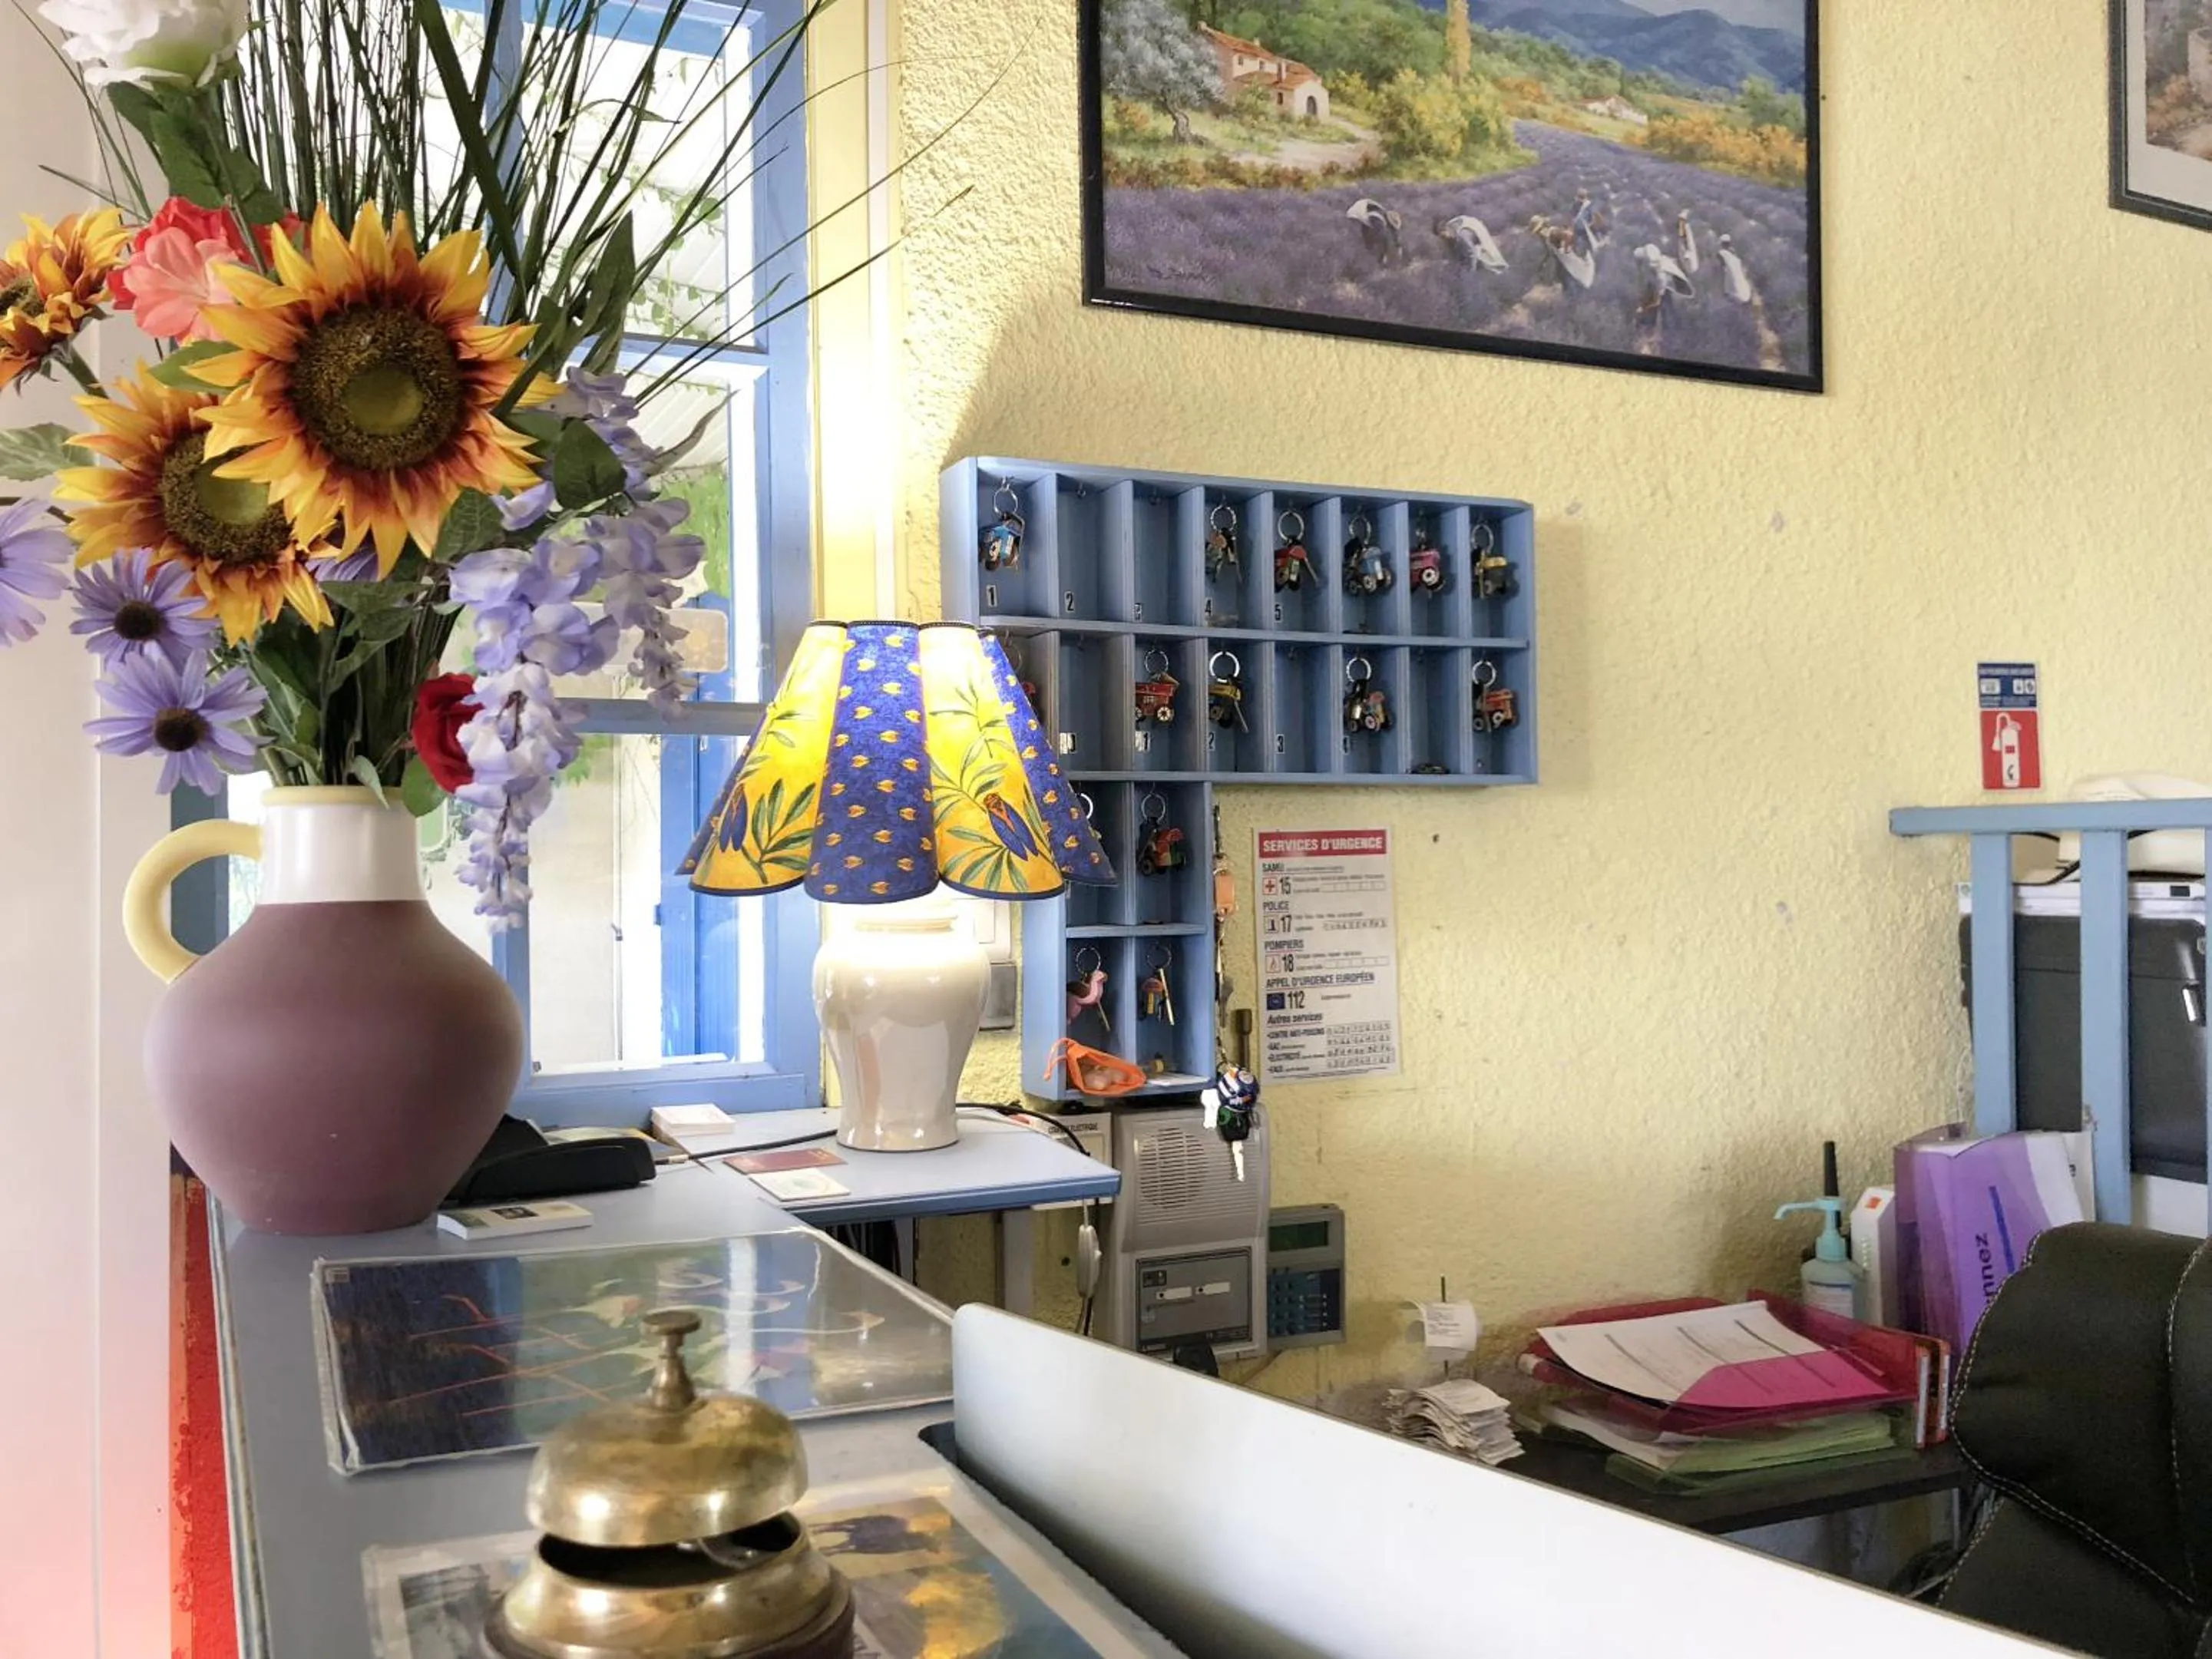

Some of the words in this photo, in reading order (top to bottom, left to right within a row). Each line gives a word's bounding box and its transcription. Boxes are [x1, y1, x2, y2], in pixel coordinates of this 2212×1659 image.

[987, 587, 995, 606] 1
[1066, 592, 1074, 612] 2
[1205, 599, 1212, 616] 4
[1275, 603, 1281, 621] 5
[1263, 838, 1318, 851] SERVICES
[1321, 836, 1383, 851] D'URGENCE
[1262, 862, 1285, 872] SAMU
[1279, 876, 1291, 894] 15
[1262, 901, 1290, 910] POLICE
[1280, 914, 1292, 932] 17
[1264, 939, 1304, 950] POMPIERS
[1281, 953, 1294, 972] 18
[1266, 977, 1290, 988] APPEL
[1291, 974, 1334, 986] D'URGENCE
[1288, 990, 1305, 1009] 112
[1268, 1014, 1291, 1024] Autres
[1292, 1013, 1323, 1022] services
[1976, 1232, 1998, 1304] nnez
